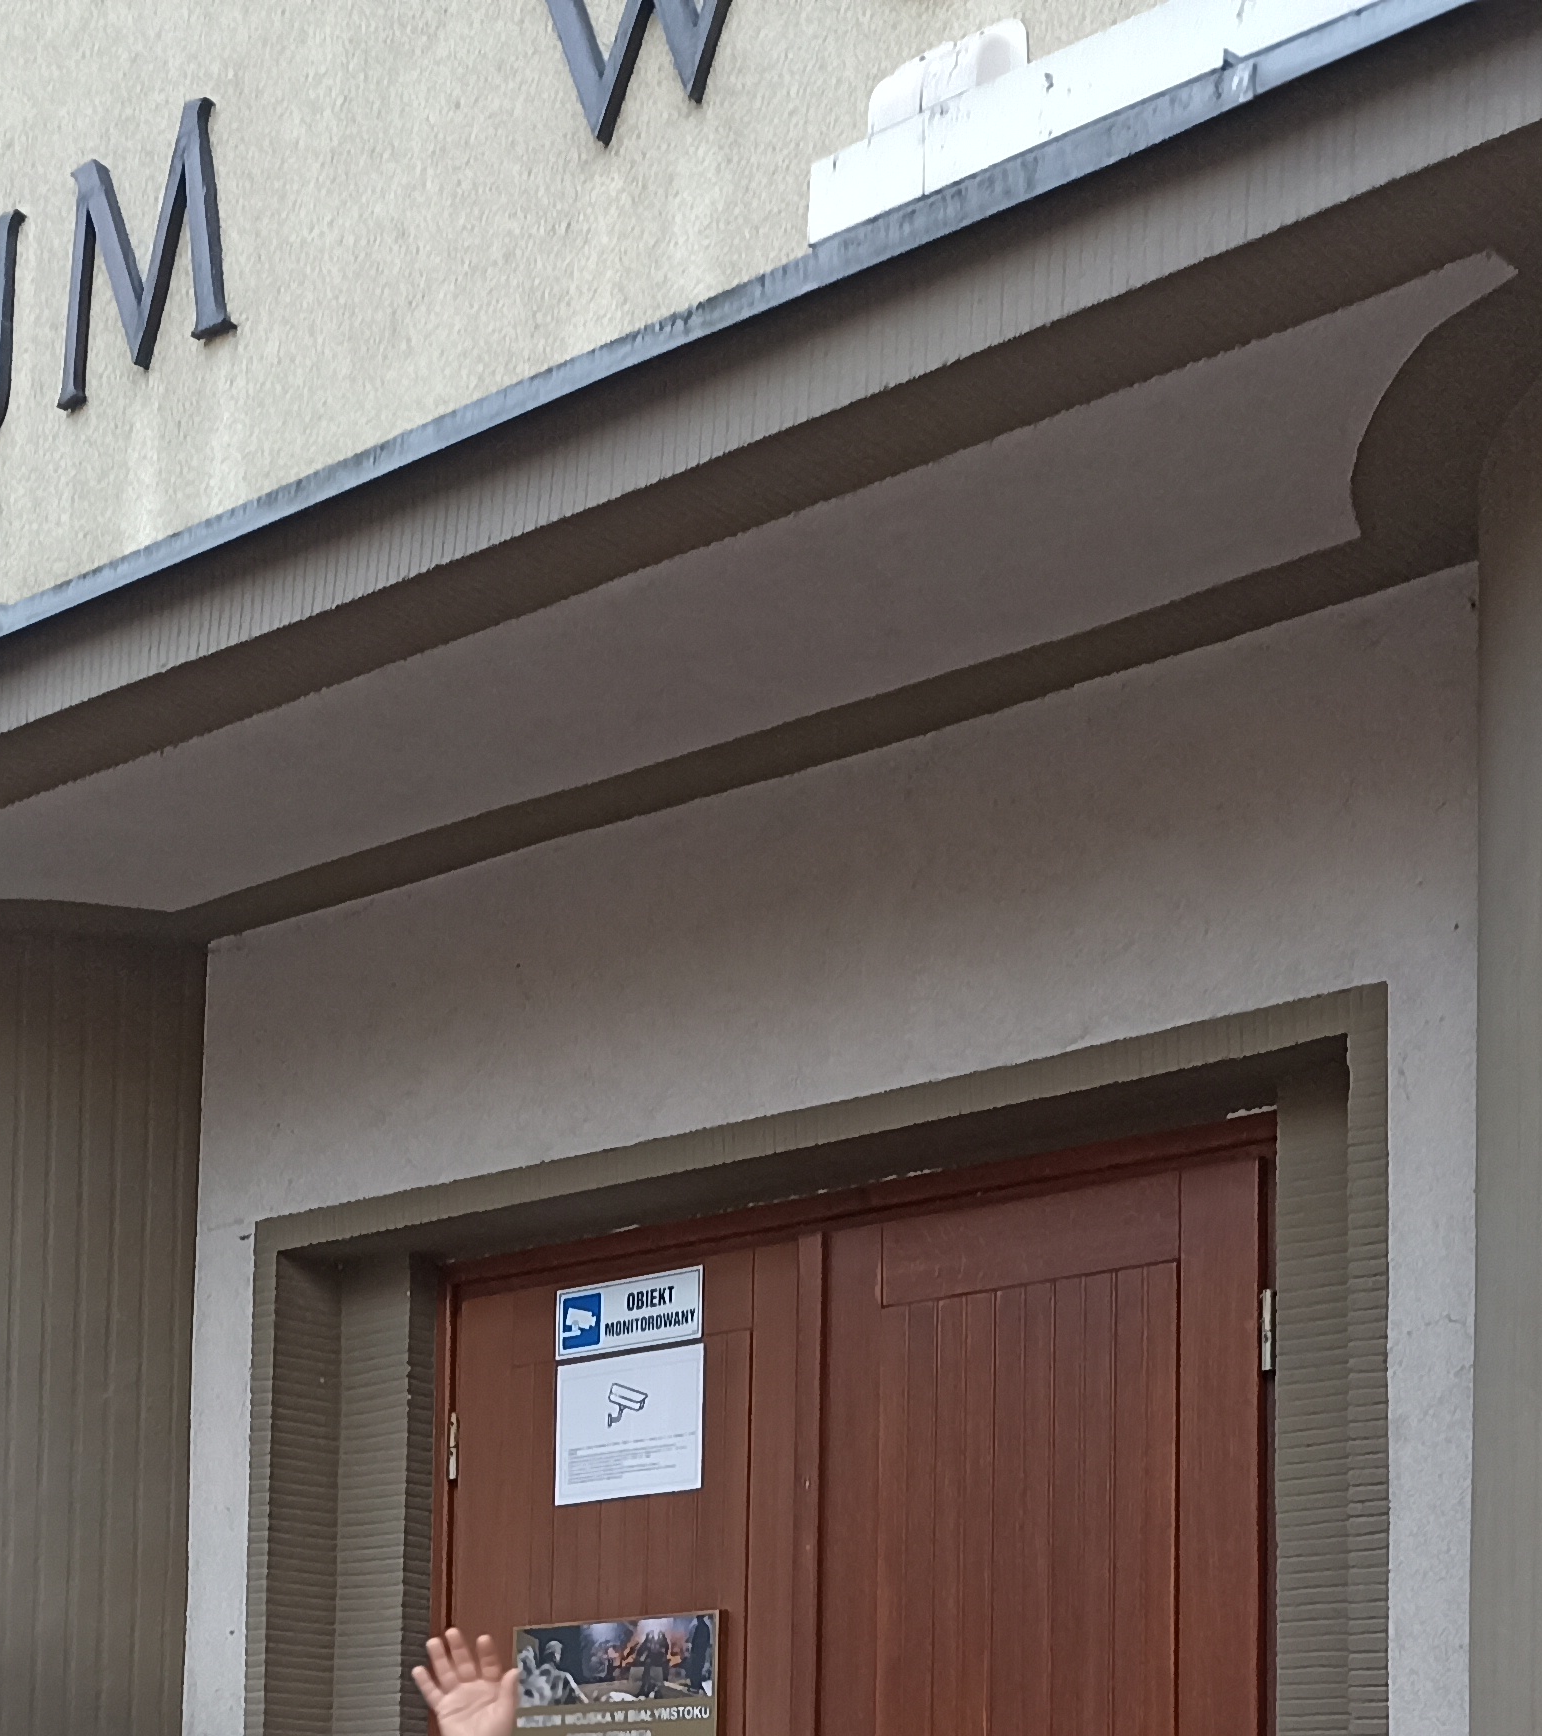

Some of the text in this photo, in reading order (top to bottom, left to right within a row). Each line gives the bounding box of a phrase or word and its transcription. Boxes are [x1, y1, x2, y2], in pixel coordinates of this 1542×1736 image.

[626, 1285, 675, 1312] OBIEKT
[604, 1308, 696, 1337] MONITOROWANY
[614, 1710, 626, 1723] W
[627, 1706, 710, 1722] BIAŁYMSTOKU
